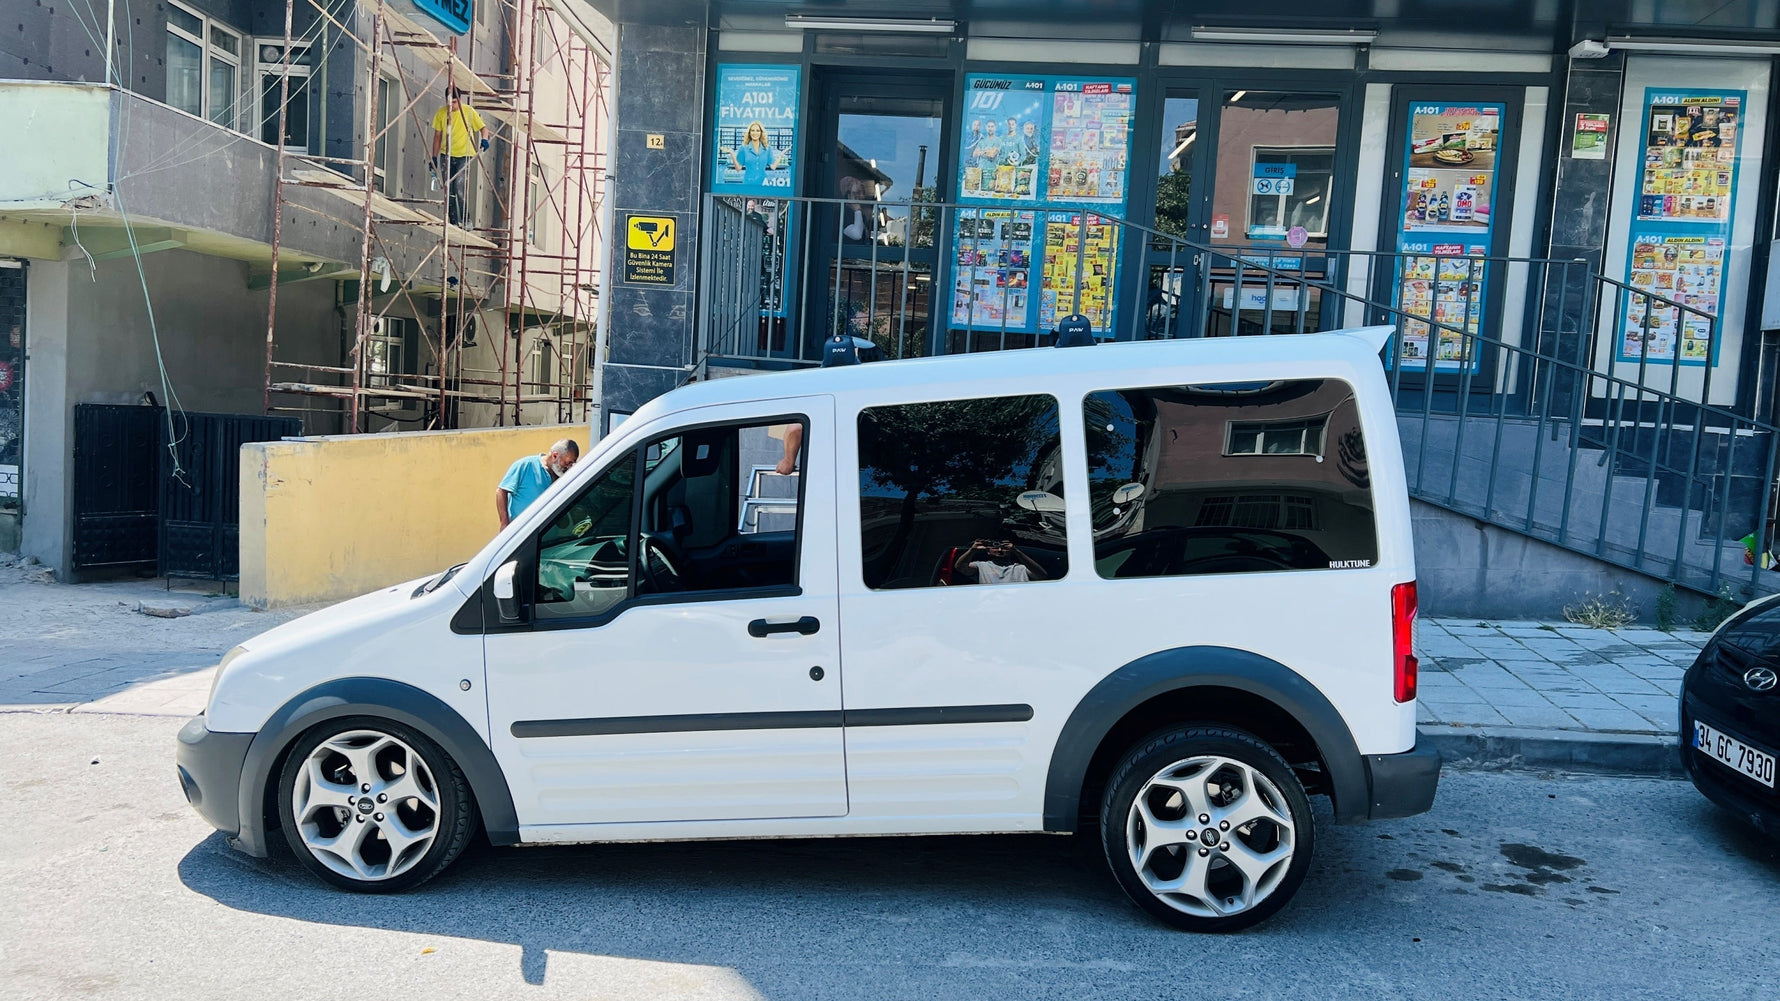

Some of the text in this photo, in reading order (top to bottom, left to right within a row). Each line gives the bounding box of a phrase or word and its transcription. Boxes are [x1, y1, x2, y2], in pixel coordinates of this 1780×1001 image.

[742, 92, 773, 104] A101
[970, 91, 1004, 112] 101
[721, 103, 794, 119] FİYATIYLA
[1328, 559, 1371, 569] HULKTUNE
[1698, 724, 1773, 783] 34 GC 7930
